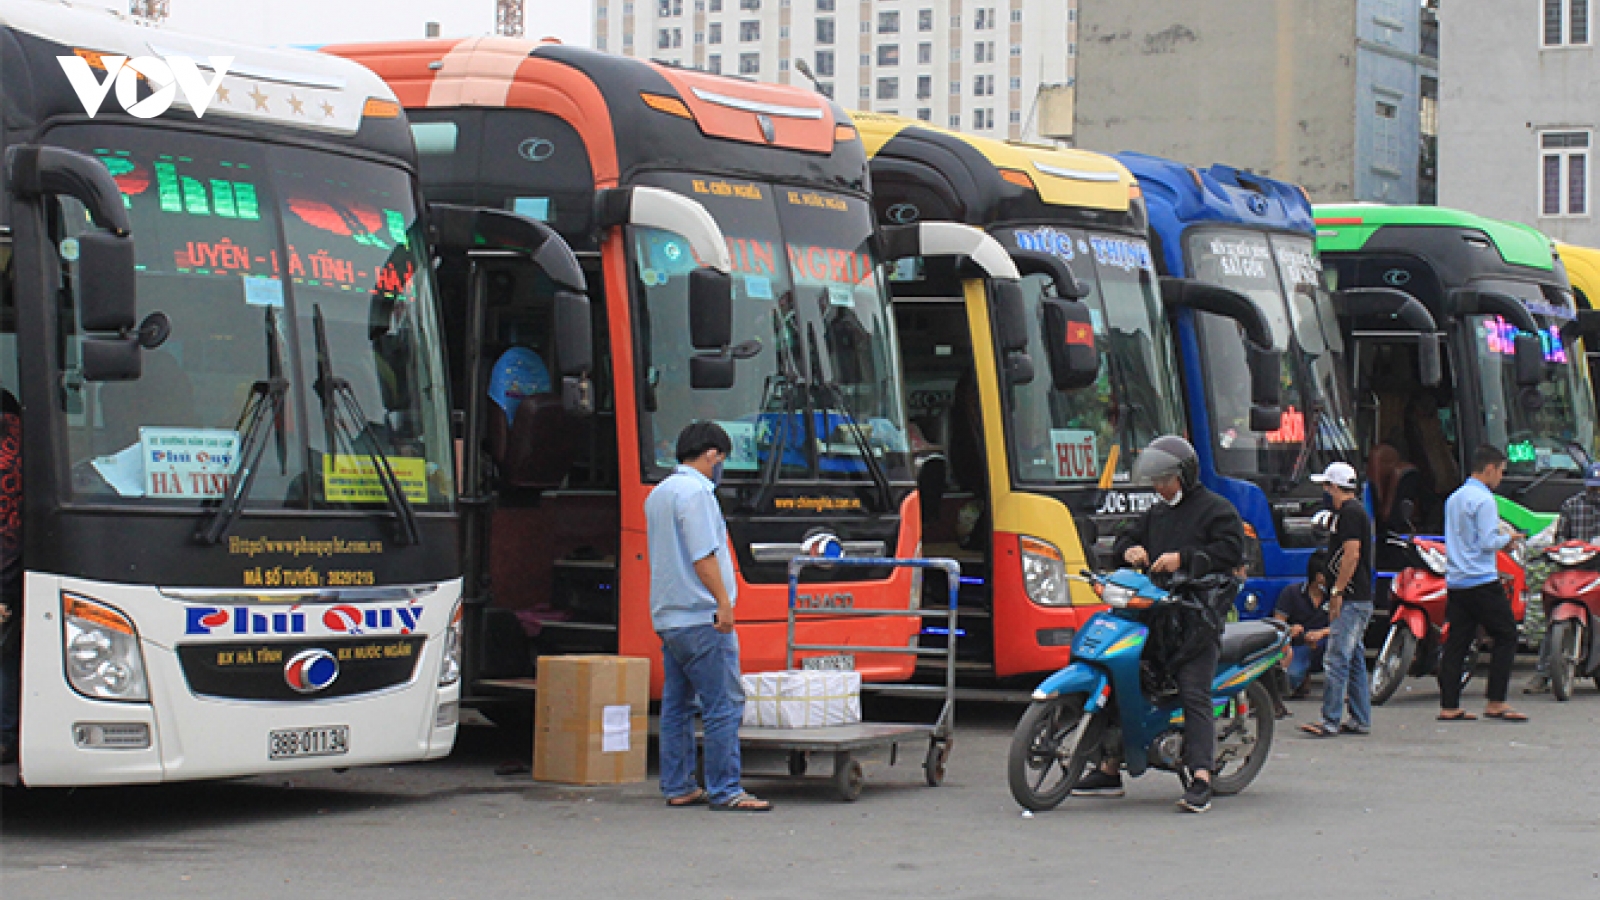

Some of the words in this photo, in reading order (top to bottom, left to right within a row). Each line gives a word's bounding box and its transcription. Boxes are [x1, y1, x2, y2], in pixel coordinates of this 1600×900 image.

[152, 449, 192, 463] Phú
[1055, 436, 1097, 477] HUẾ
[151, 464, 184, 494] HÀ
[188, 465, 235, 494] TĨN
[243, 567, 263, 586] MÃ
[797, 592, 853, 610] THACO
[185, 604, 307, 635] Phú
[322, 599, 423, 636] Quý
